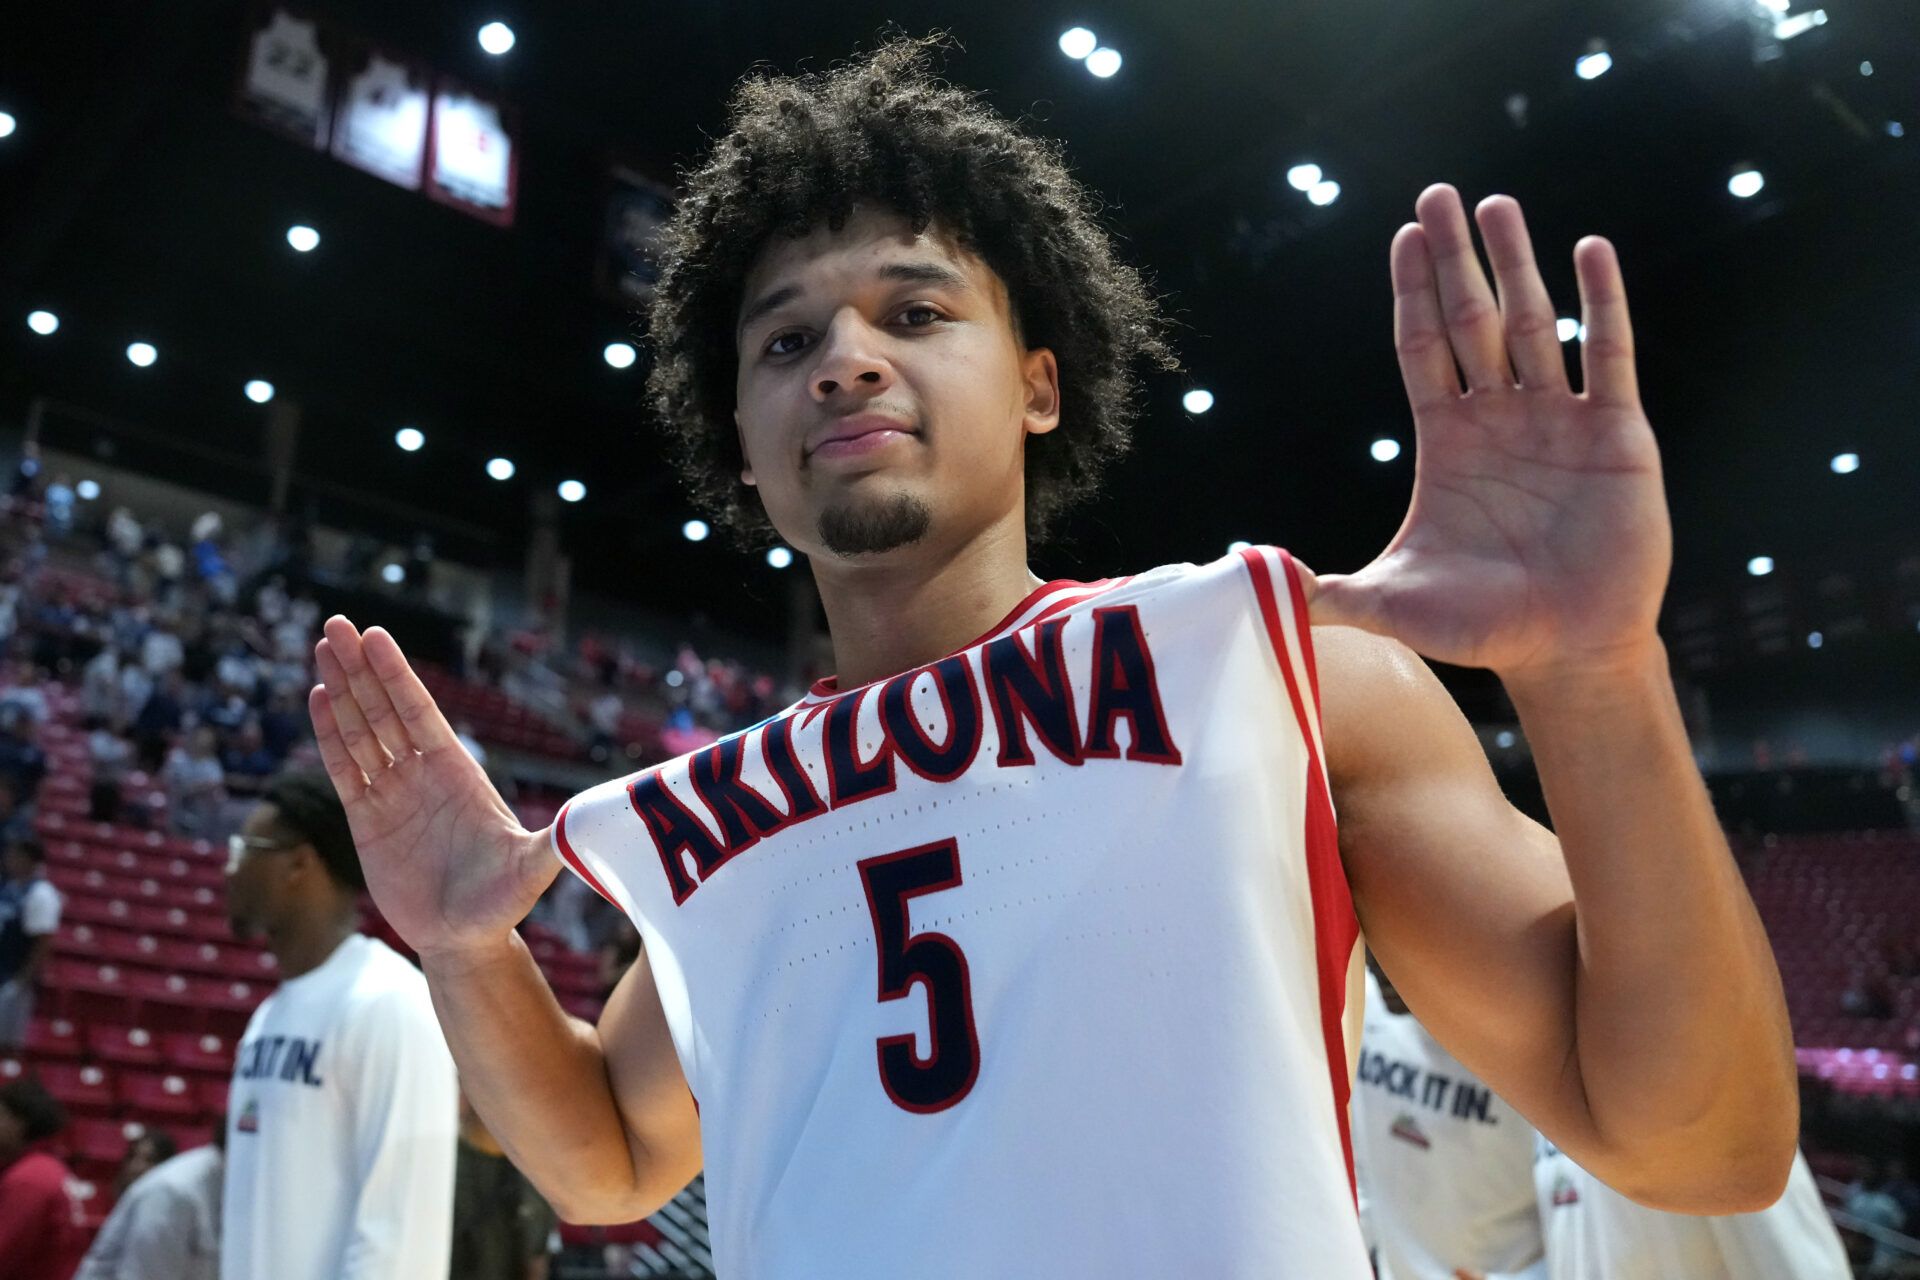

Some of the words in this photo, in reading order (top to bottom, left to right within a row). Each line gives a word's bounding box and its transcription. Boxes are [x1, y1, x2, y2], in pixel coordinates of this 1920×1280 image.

[626, 604, 1182, 908] ARIZONA
[857, 837, 980, 1114] 5
[1358, 1047, 1419, 1100] LOCK
[1422, 1072, 1451, 1112] IT
[1451, 1081, 1499, 1125] IN.
